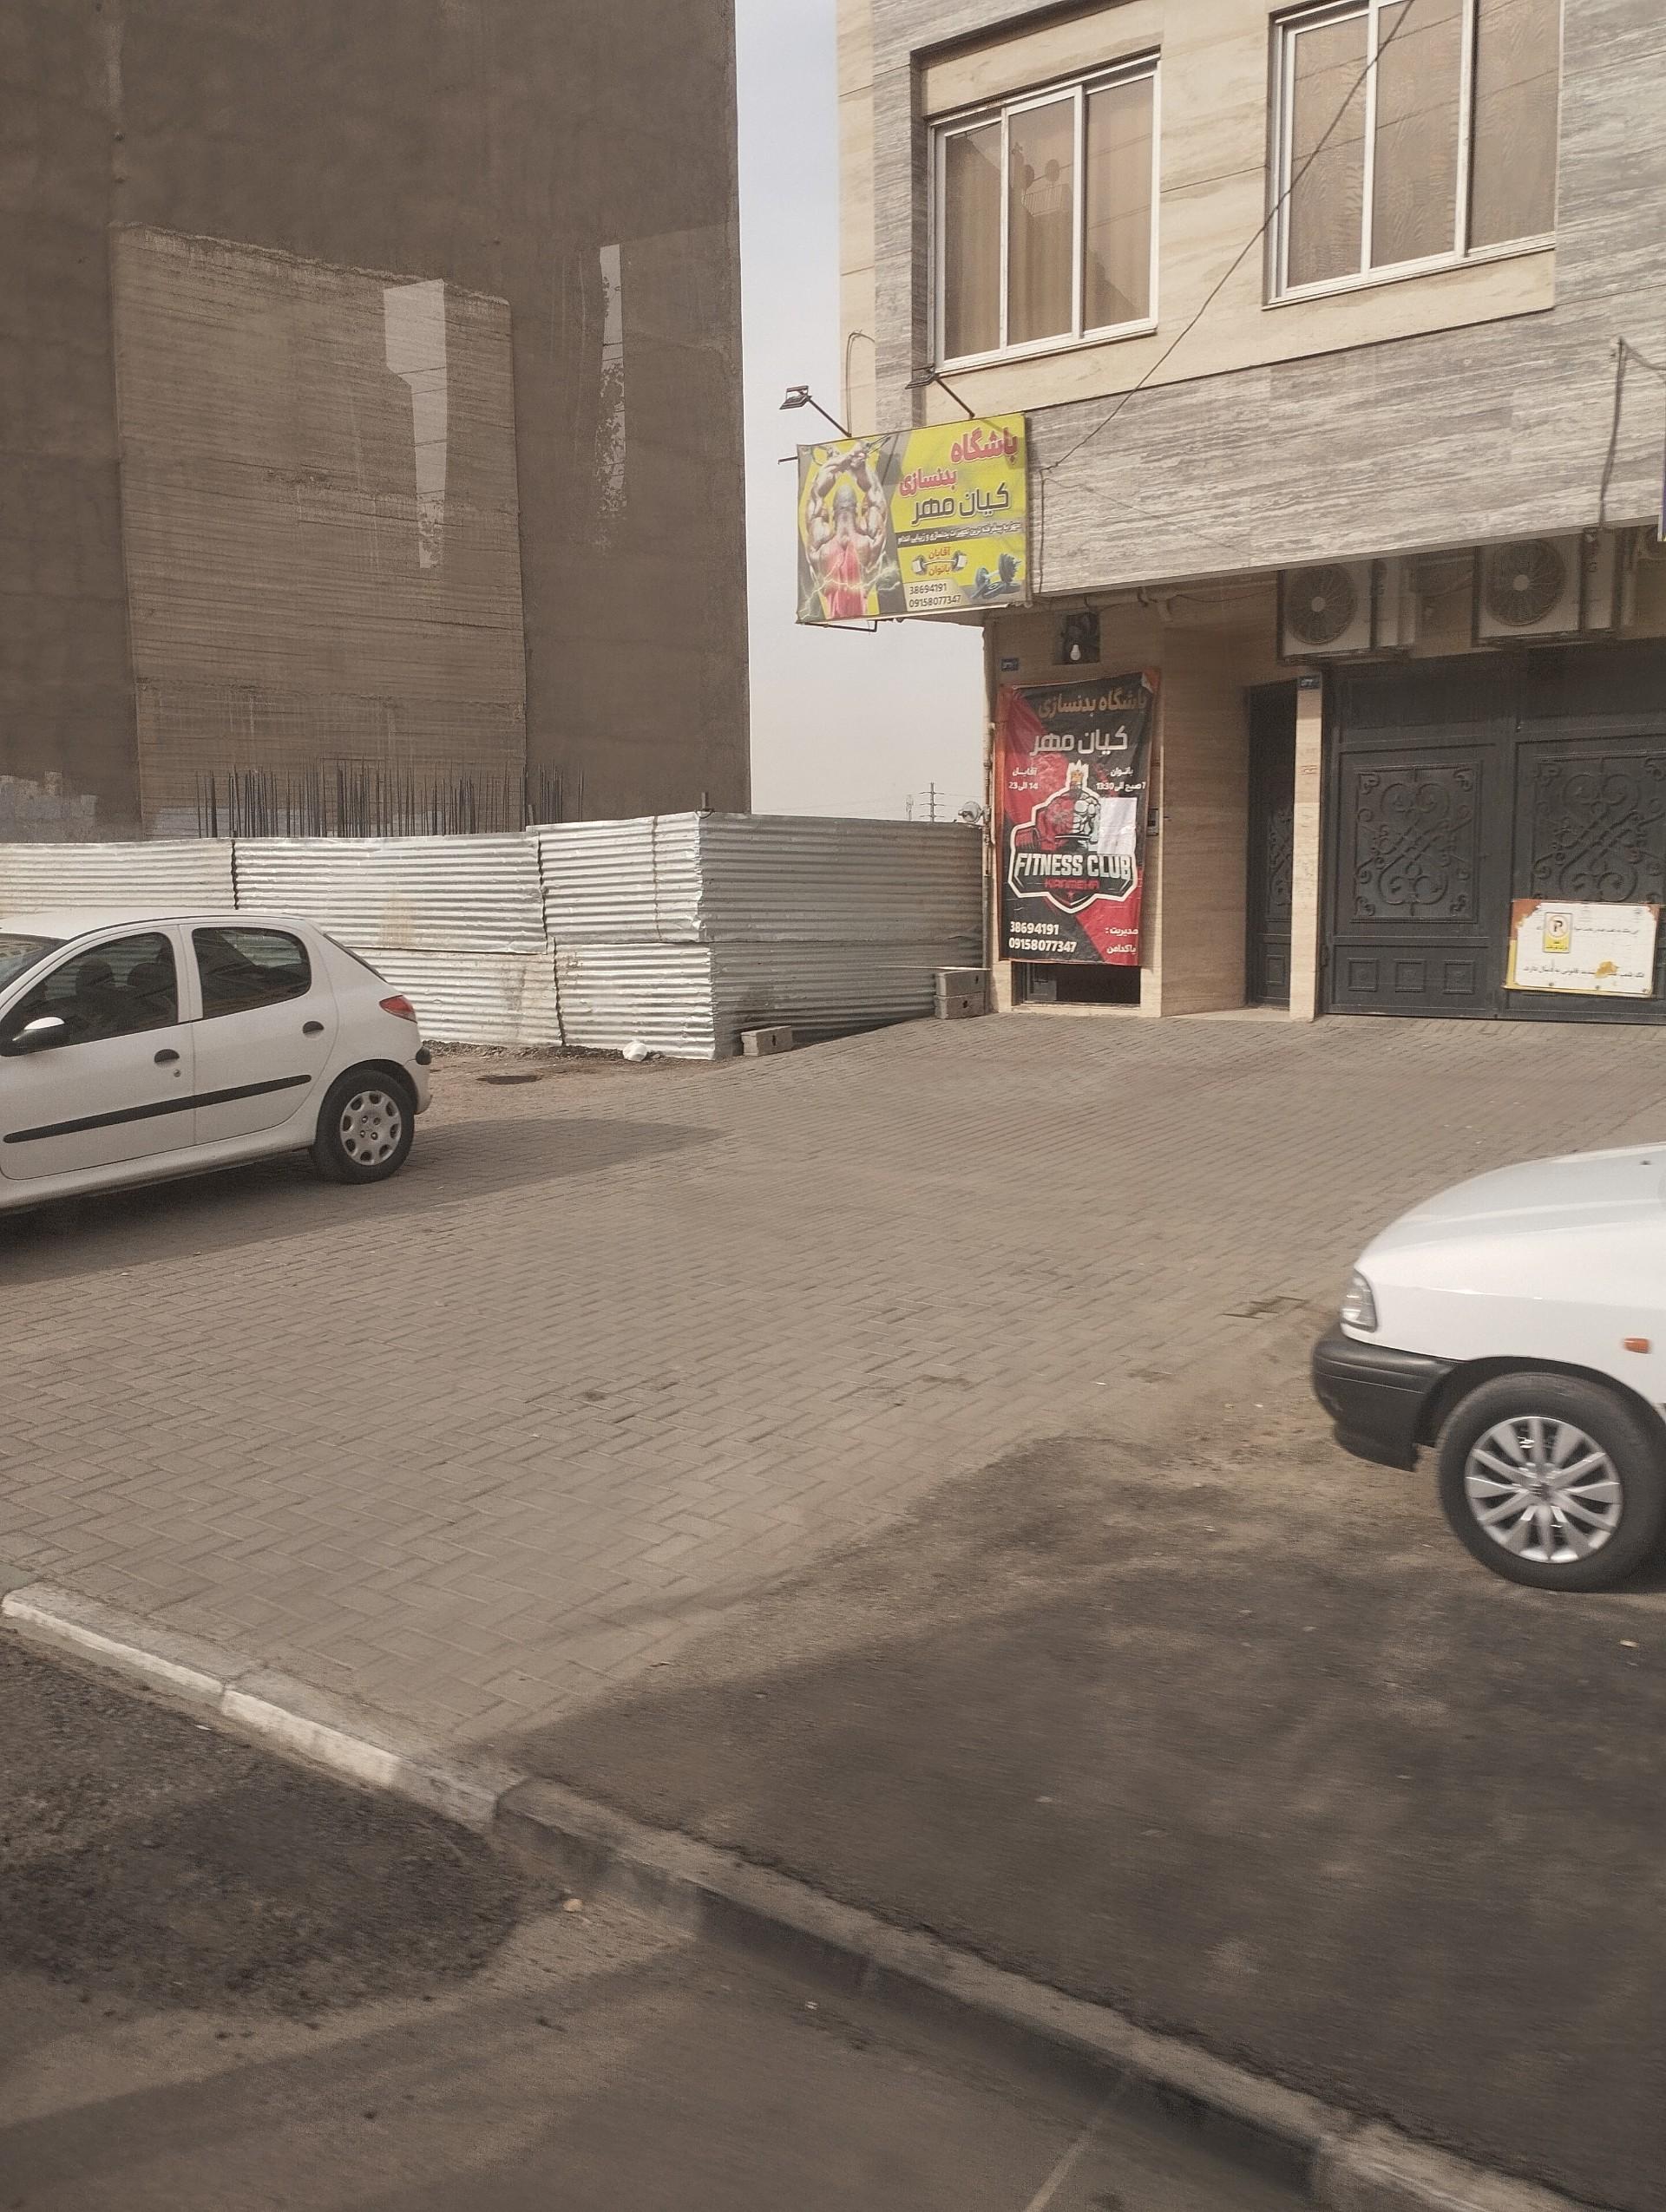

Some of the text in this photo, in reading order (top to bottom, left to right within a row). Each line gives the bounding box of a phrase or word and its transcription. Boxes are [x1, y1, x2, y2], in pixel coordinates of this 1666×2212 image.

[951, 427, 1019, 464] باشگاه
[899, 468, 957, 498] بدنسازی
[910, 481, 1010, 526] کیان مهر
[928, 546, 951, 560] آقایان
[928, 563, 952, 576] بانوان
[908, 583, 948, 595] 38694191
[908, 594, 961, 608] 09158077347
[1038, 688, 1147, 719] باشگاه بدنسازی
[1029, 725, 1128, 756] کیان مهر
[1012, 767, 1038, 777] آقایان
[1110, 766, 1133, 777] بانوان
[1008, 781, 1018, 789] 23
[1015, 853, 1132, 880] FITNESS CLUB
[1009, 920, 1059, 936] 38694191
[1008, 937, 1078, 953] 09158077347
